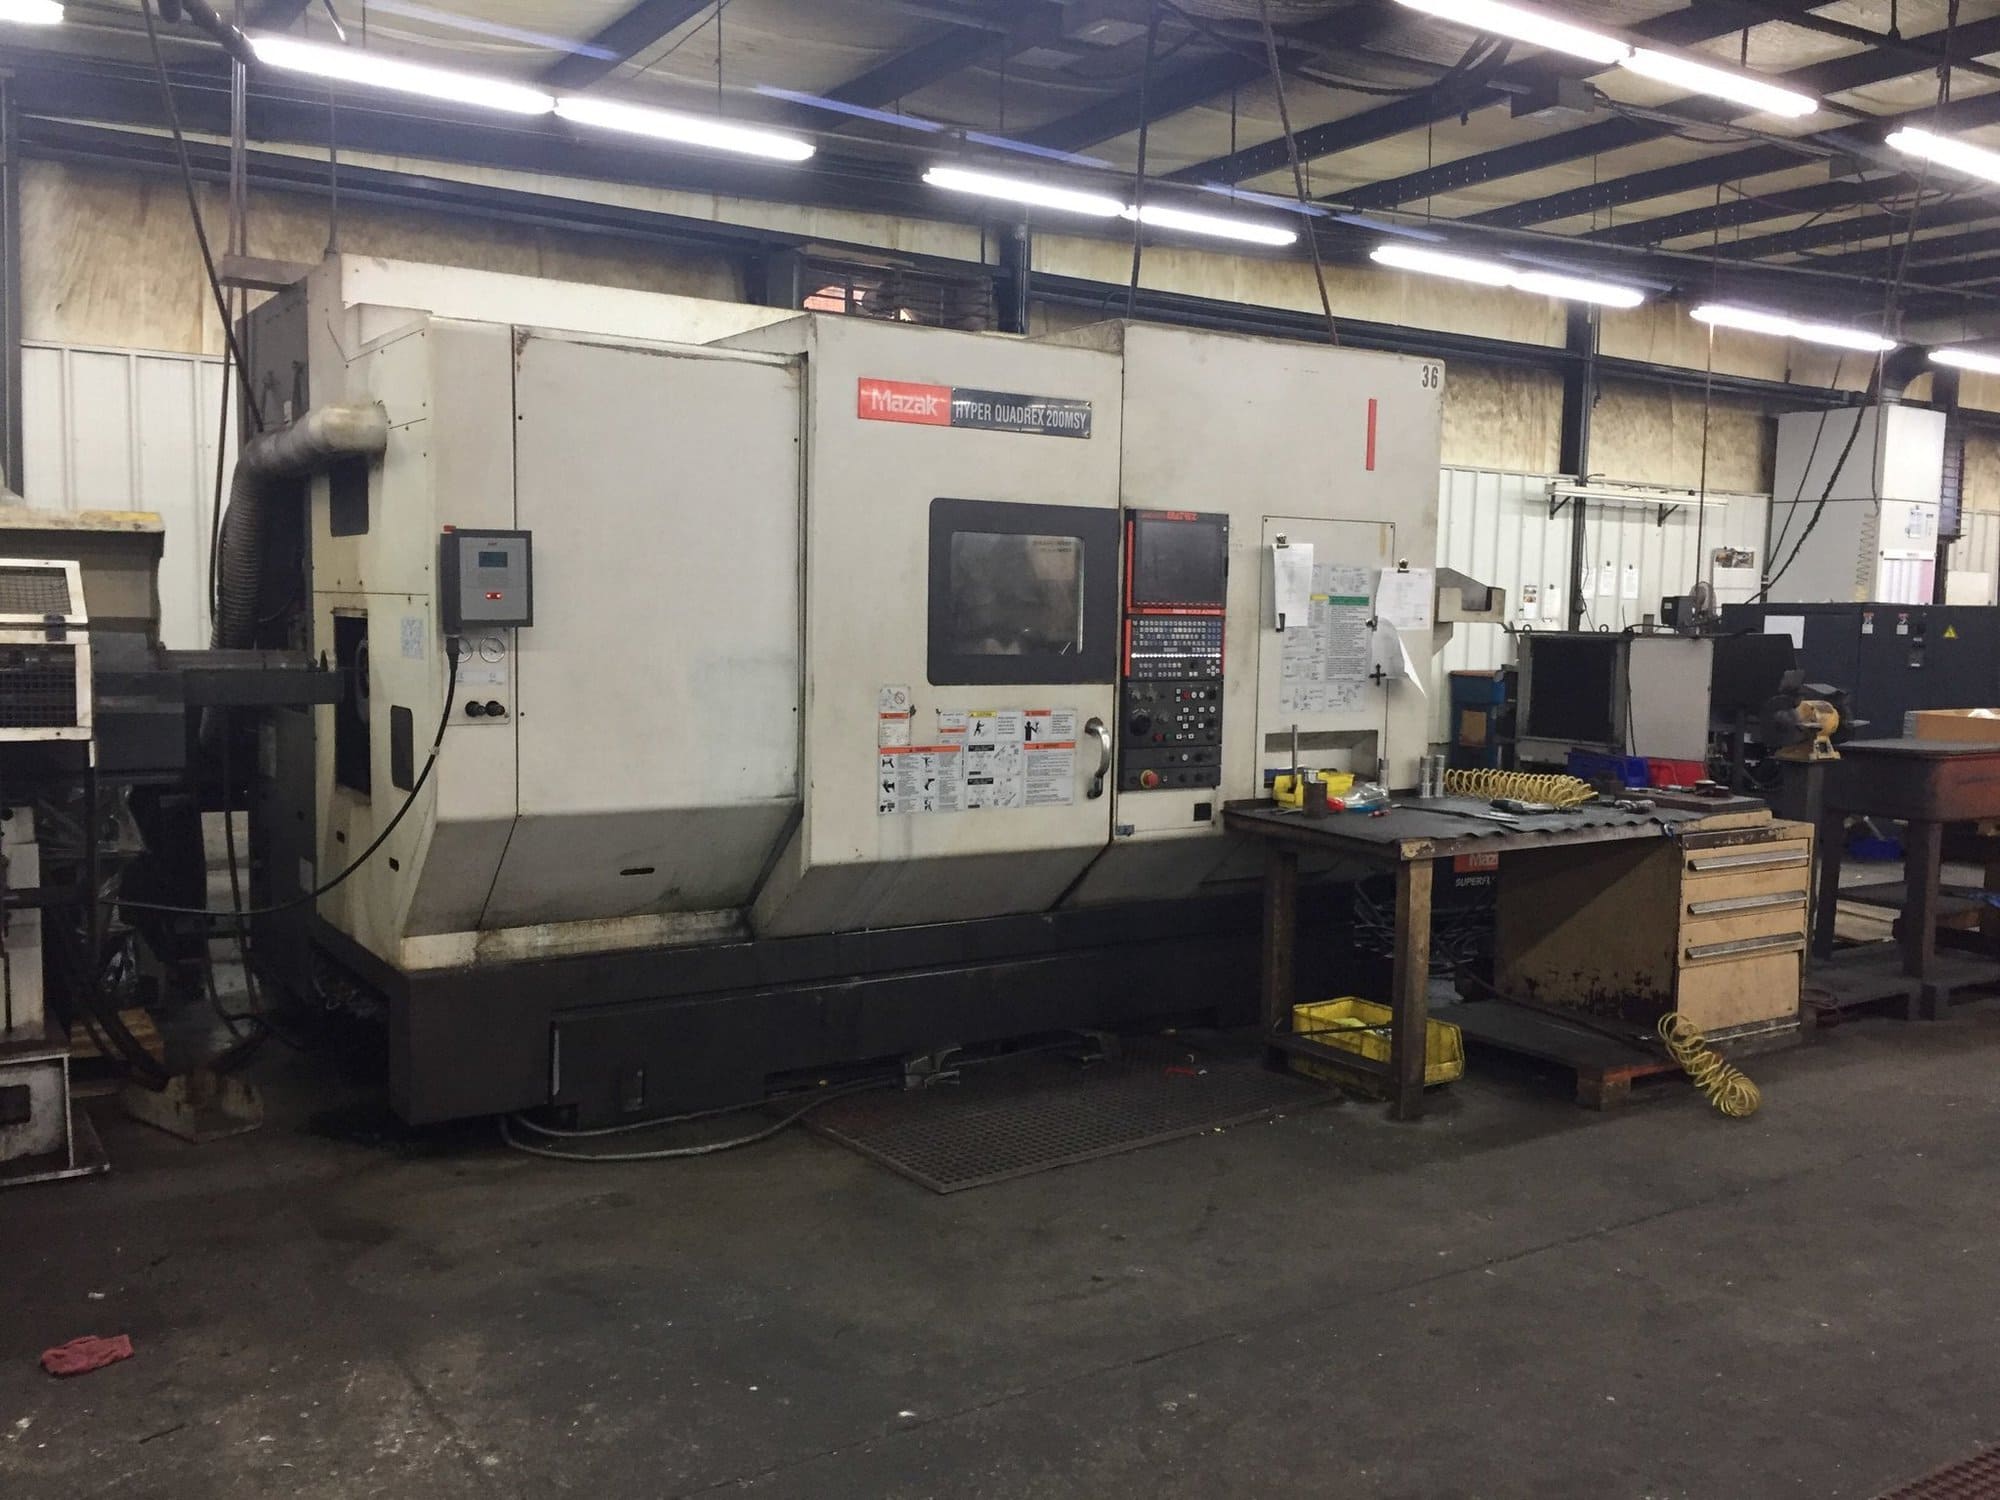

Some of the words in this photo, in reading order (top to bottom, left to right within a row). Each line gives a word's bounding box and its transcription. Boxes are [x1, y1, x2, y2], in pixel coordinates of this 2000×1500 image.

[1422, 365, 1438, 389] 36
[868, 389, 940, 417] Mazak
[955, 403, 991, 421] HYPER
[995, 406, 1044, 426] QUADREX
[1046, 411, 1087, 430] 200MSY
